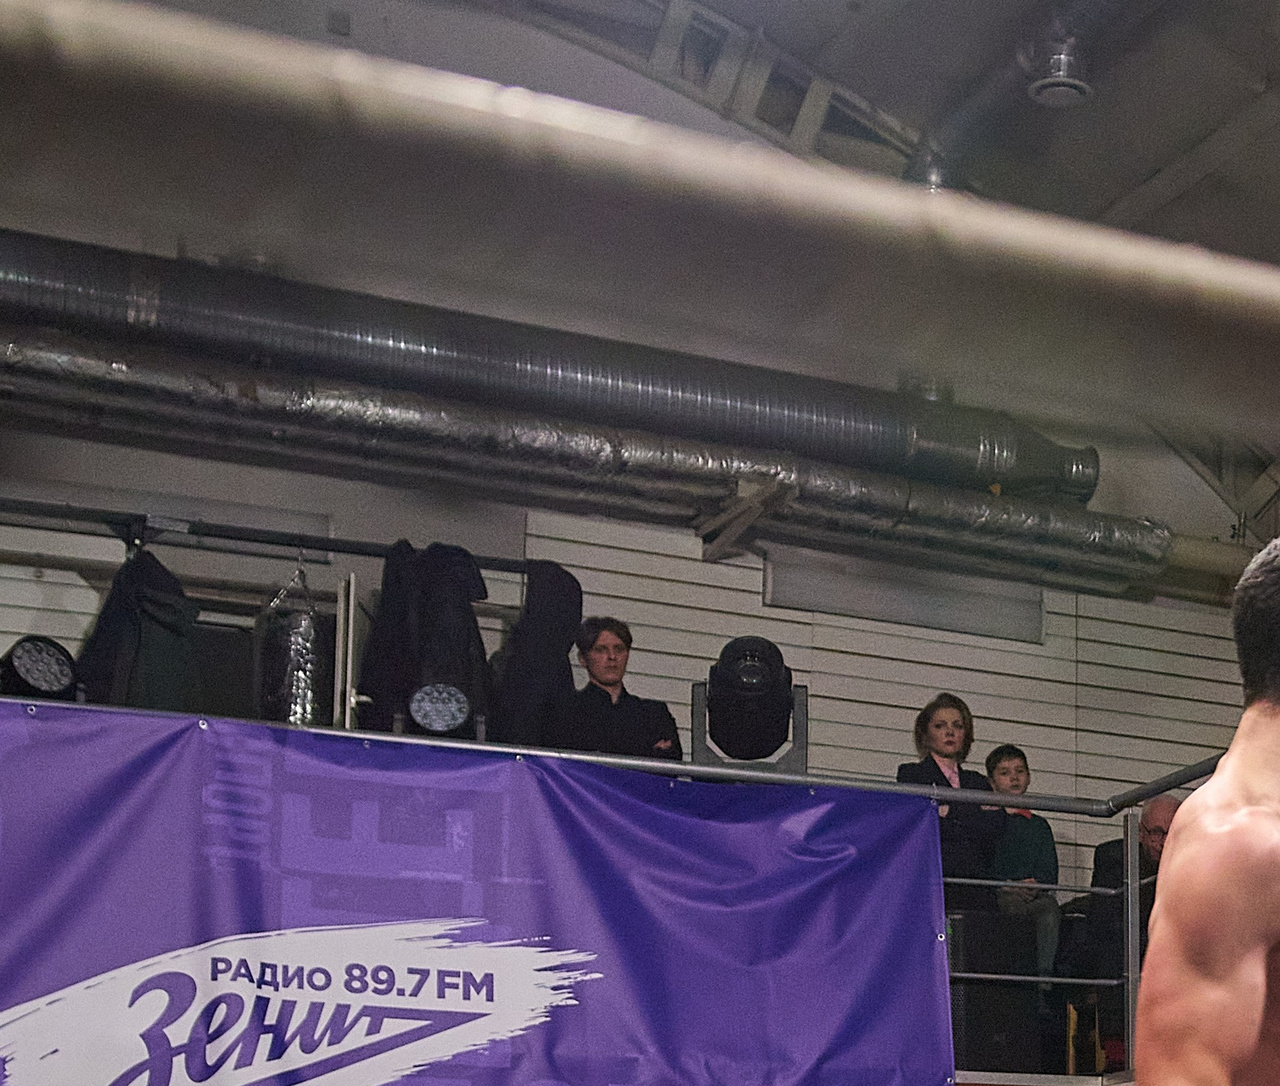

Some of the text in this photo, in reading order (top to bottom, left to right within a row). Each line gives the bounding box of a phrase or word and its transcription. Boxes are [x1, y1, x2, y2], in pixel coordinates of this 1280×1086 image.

[210, 957, 495, 1002] РАДИО 89.7 FM
